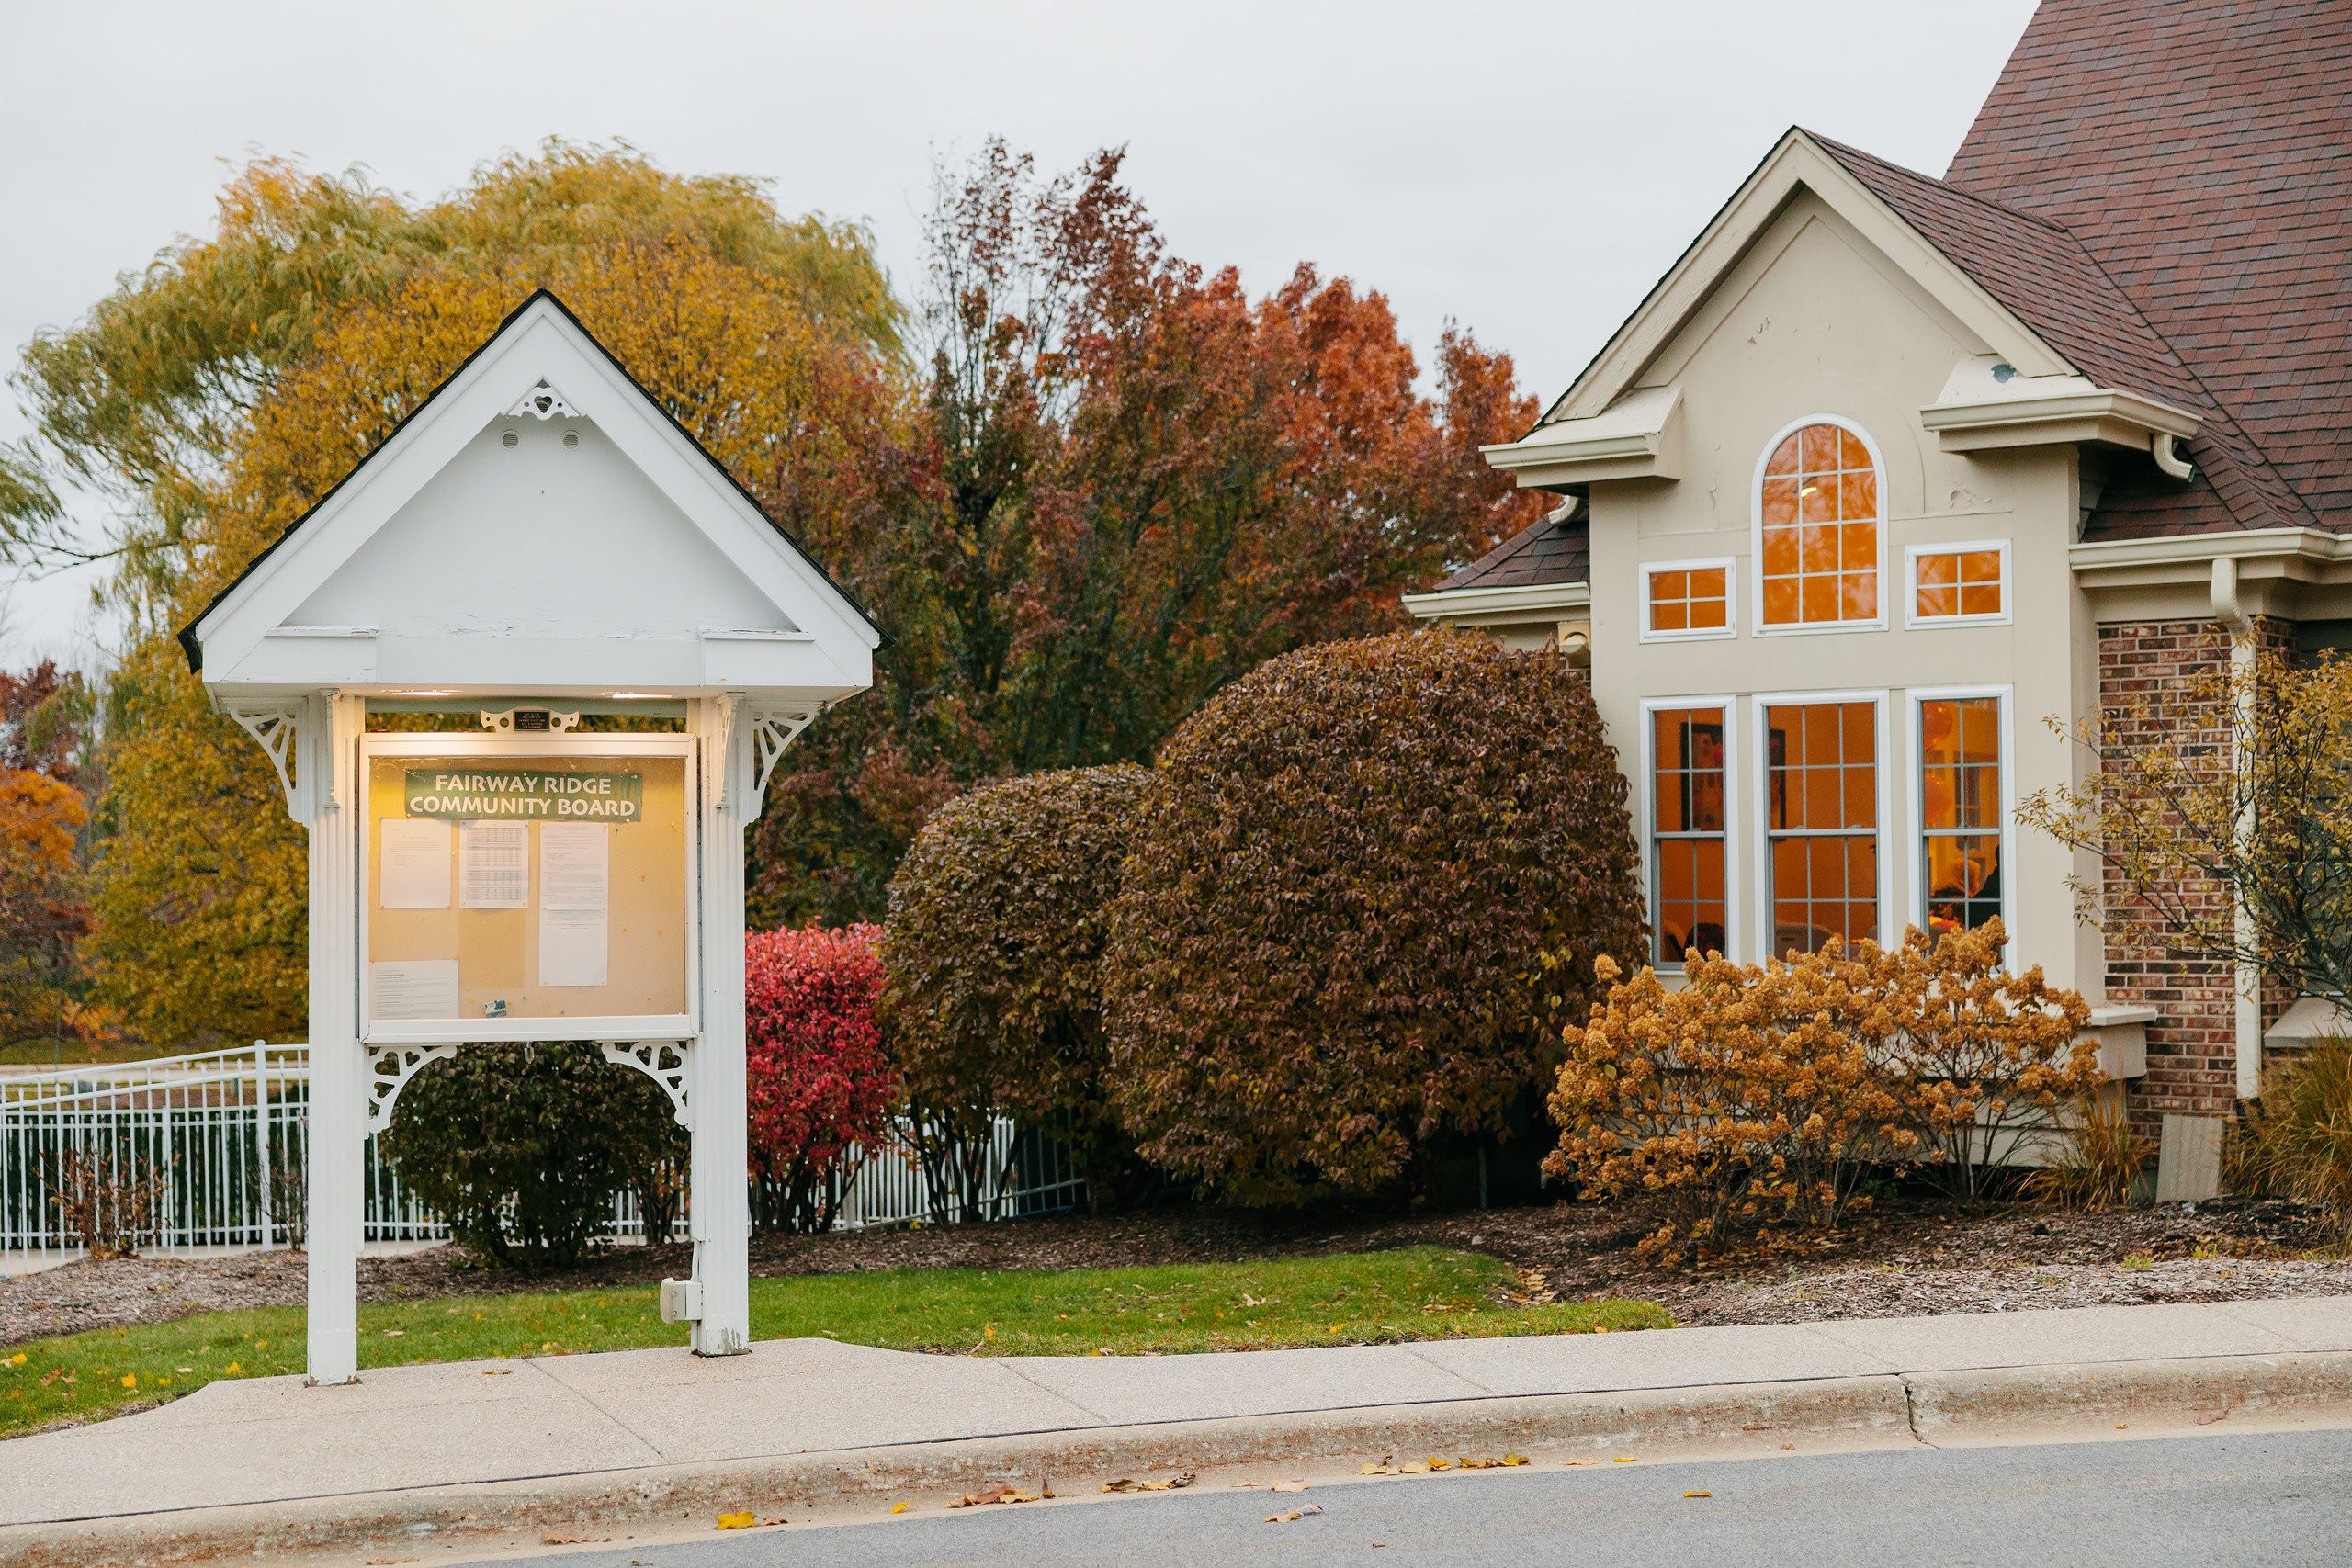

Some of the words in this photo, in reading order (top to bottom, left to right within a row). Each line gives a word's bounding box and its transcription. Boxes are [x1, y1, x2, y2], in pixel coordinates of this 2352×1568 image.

[435, 774, 538, 793] FAIRWAY
[544, 777, 611, 795] RIDGE
[410, 796, 551, 814] COMMUNITY
[558, 798, 635, 817] BOARD
